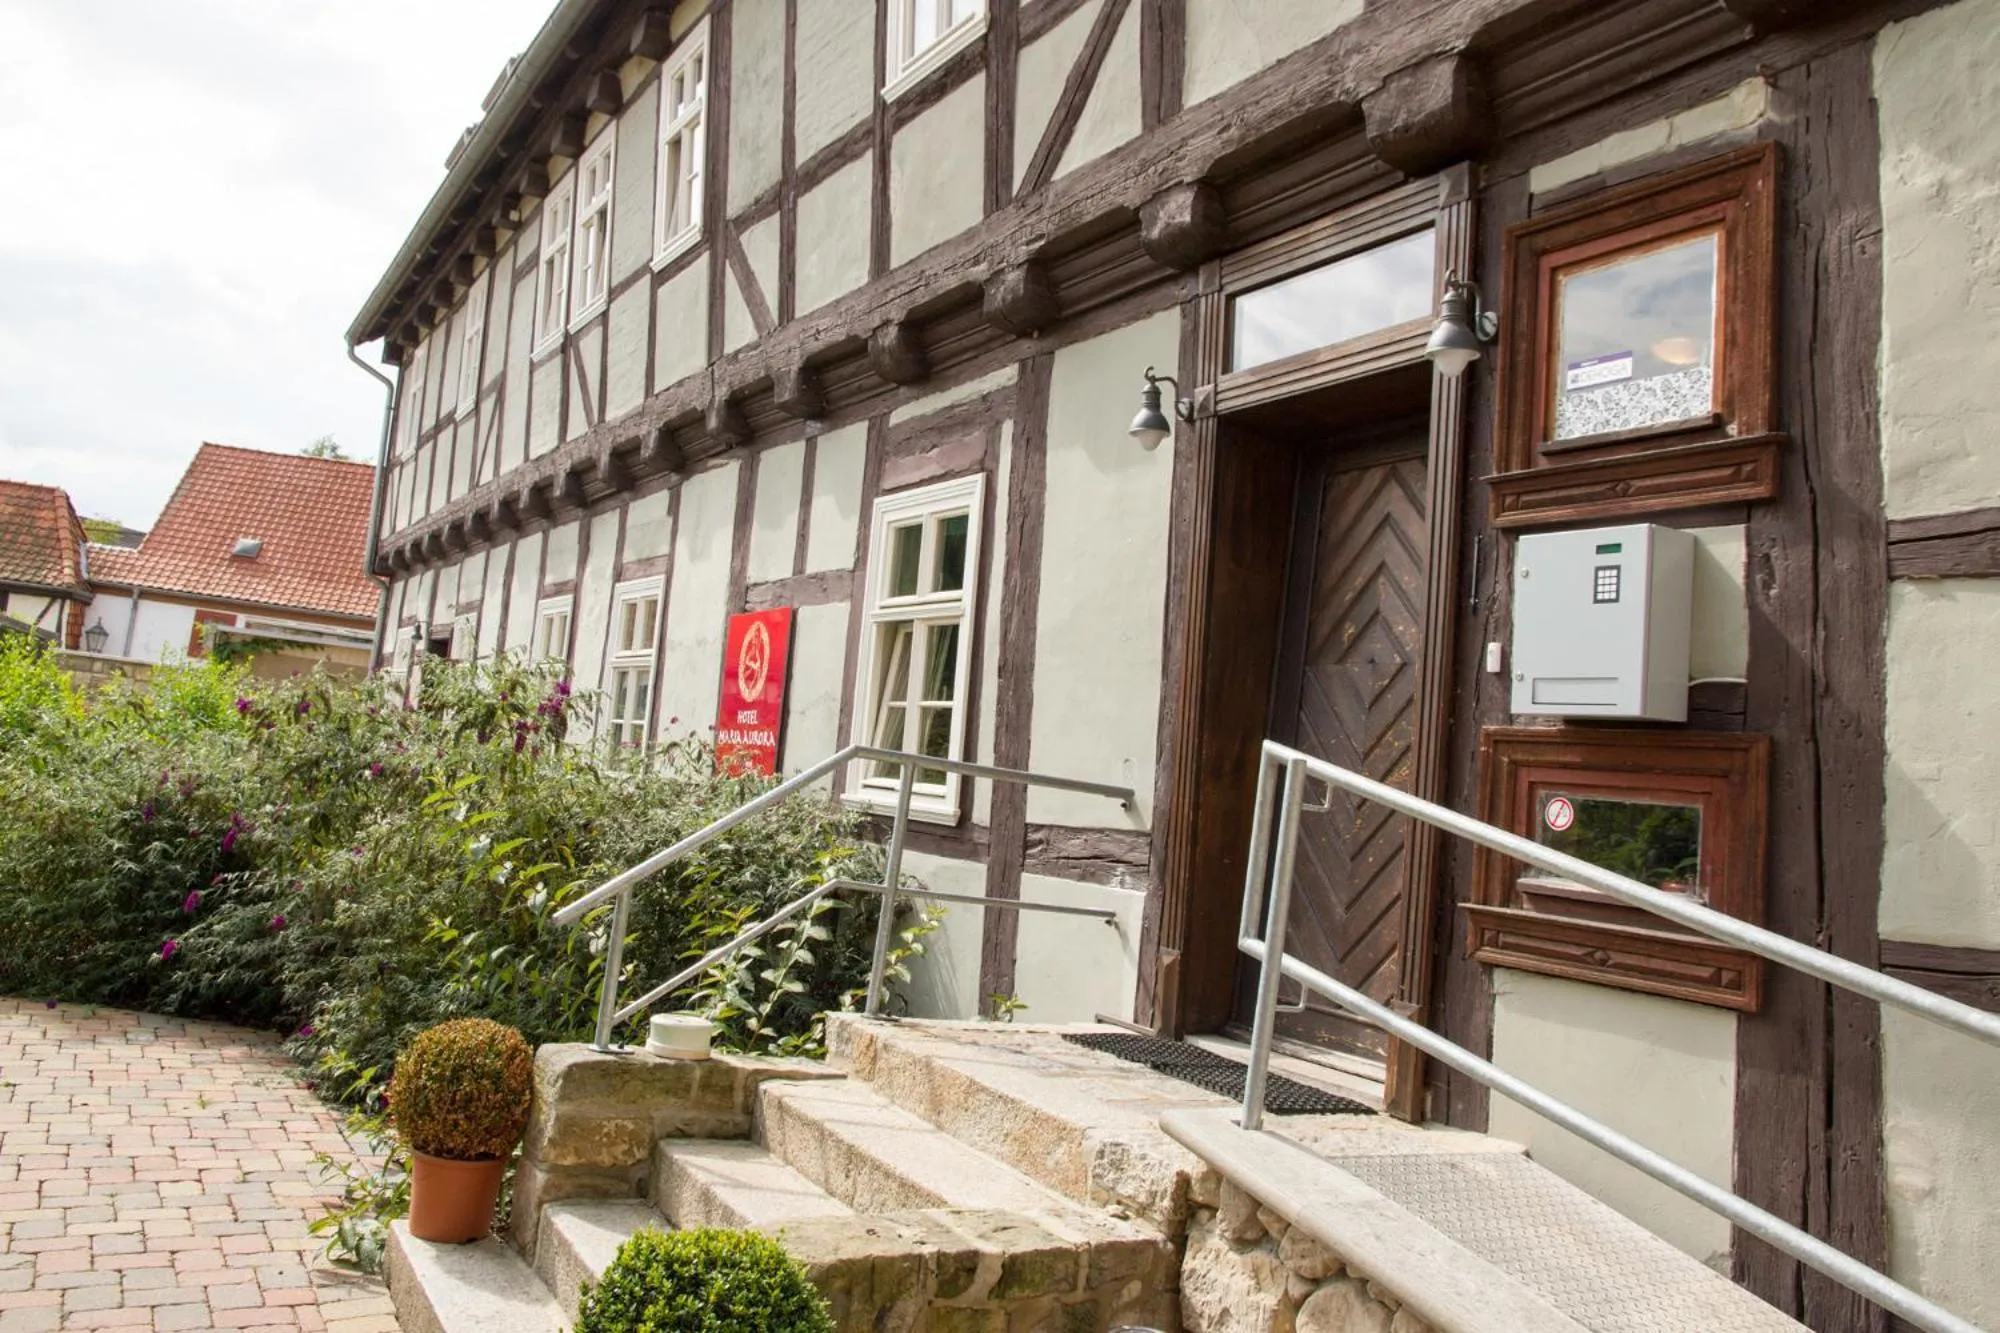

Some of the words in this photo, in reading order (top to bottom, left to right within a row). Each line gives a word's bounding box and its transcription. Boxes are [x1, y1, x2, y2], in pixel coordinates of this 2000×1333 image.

[737, 710, 758, 725] HOTEL
[718, 729, 741, 744] MARIA
[742, 730, 775, 747] AURORA
